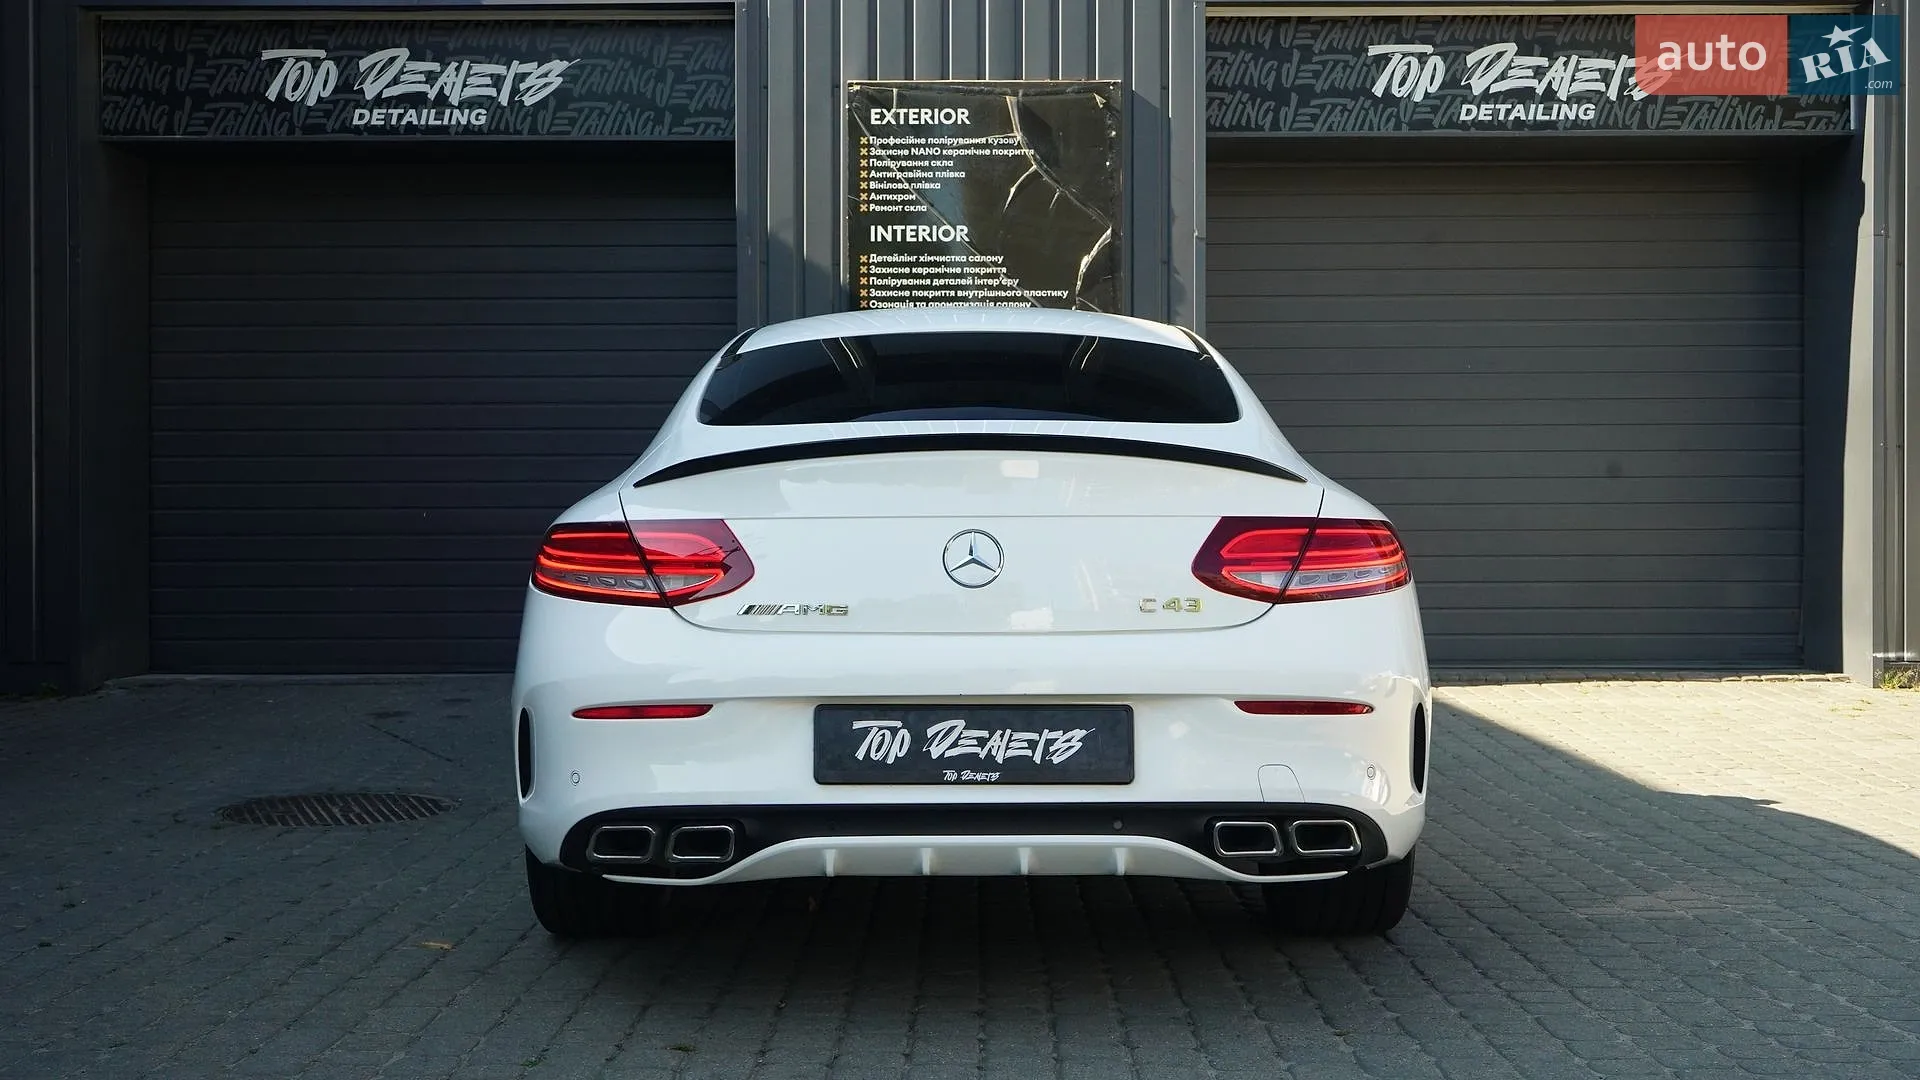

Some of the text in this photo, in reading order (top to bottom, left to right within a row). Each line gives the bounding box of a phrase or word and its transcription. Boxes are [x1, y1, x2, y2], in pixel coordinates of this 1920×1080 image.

[352, 108, 488, 126] DETAILING
[870, 108, 971, 125] EXTERIOR
[1459, 103, 1596, 121] DETAILING
[869, 136, 1018, 146] Професійне полірування кузову
[869, 147, 1034, 157] Захисне NANO керамічне покриття
[869, 158, 929, 169] Полірування
[869, 170, 966, 180] Антигравійна плівка
[869, 181, 941, 190] Вінілова плівка
[869, 192, 916, 202] Антихром
[869, 204, 927, 212] Ремонт скла
[870, 225, 971, 242] INTERIOR
[869, 253, 1004, 264] Детейлінг хімчистка салону
[869, 265, 1007, 275] Захисне керамічне покриття
[869, 276, 931, 287] Полірування
[932, 276, 973, 286] деталей
[869, 288, 1069, 299] Захисне покриття внутрішнього пластику
[916, 301, 926, 309] та
[777, 602, 849, 616] AMG
[1139, 597, 1203, 613] C 43
